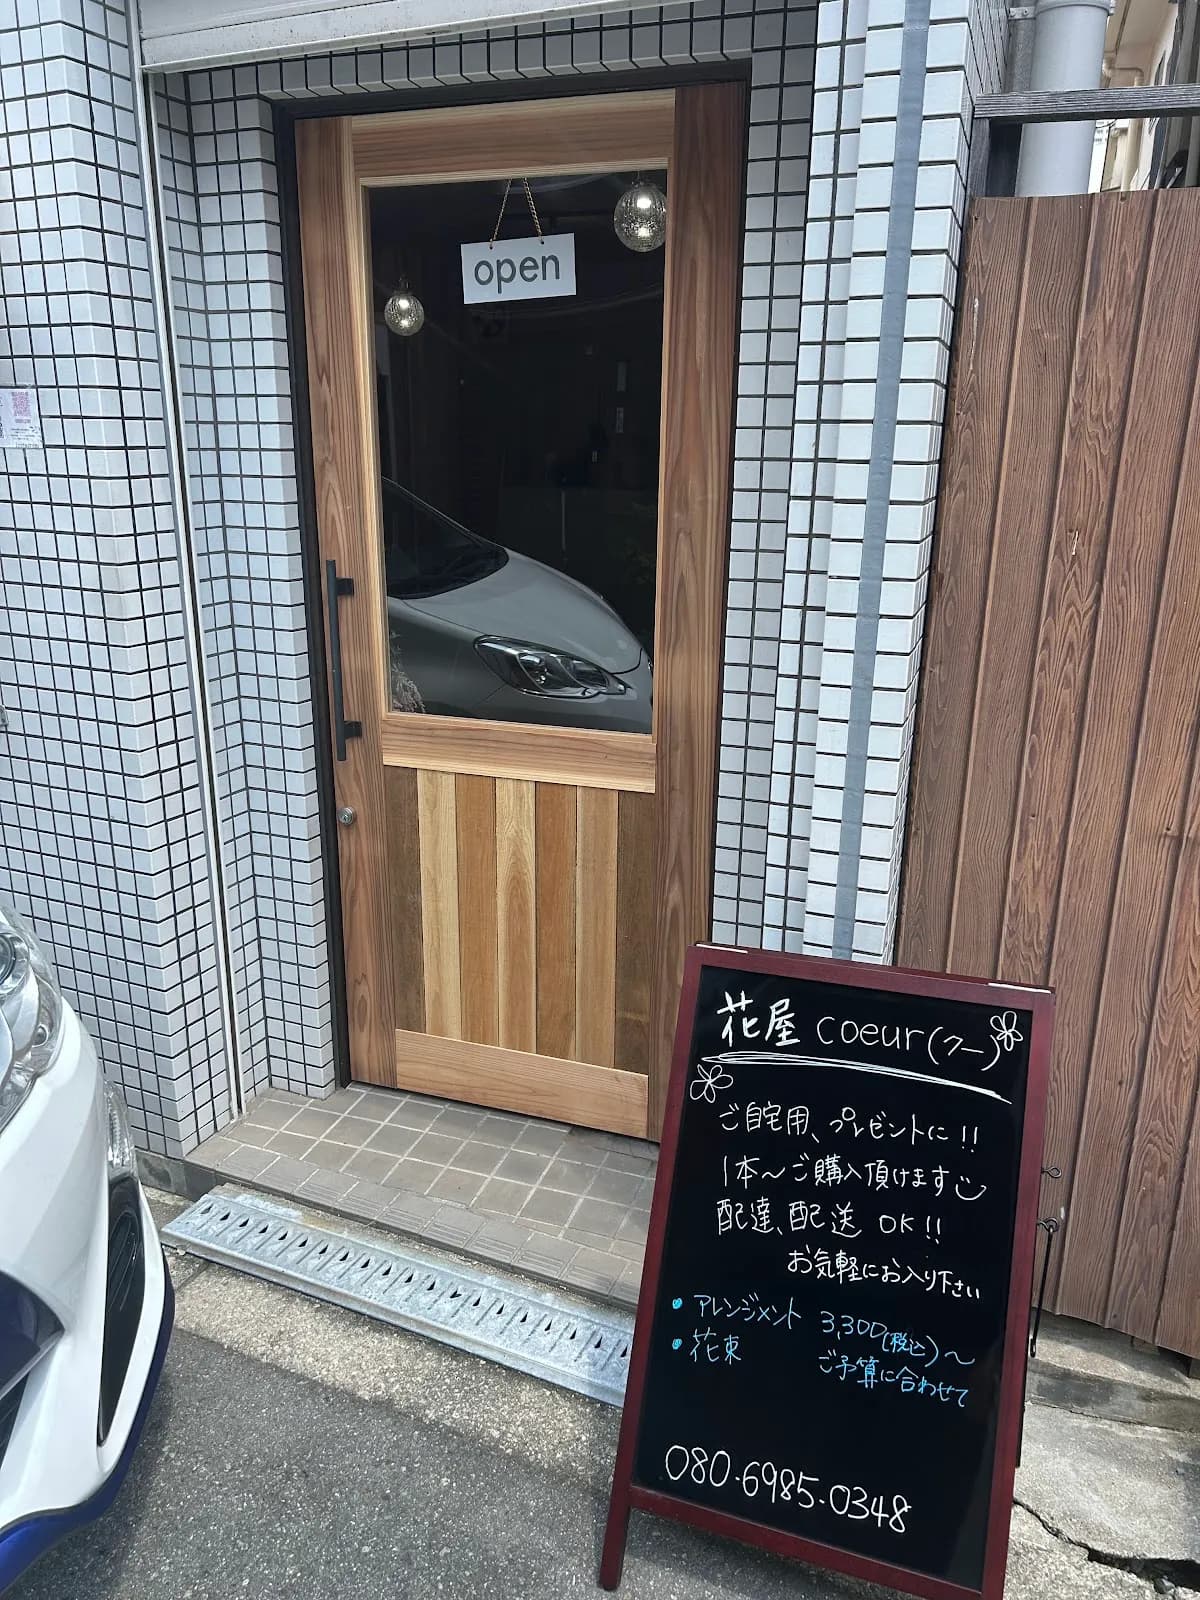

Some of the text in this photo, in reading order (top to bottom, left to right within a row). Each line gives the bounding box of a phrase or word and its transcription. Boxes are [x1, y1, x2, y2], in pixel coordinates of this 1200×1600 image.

[474, 254, 560, 294] open
[716, 990, 801, 1048] 花屋
[786, 1243, 981, 1300] お気軽にお入り下さい
[689, 1326, 968, 1408] 花束 ご予算に合わせて
